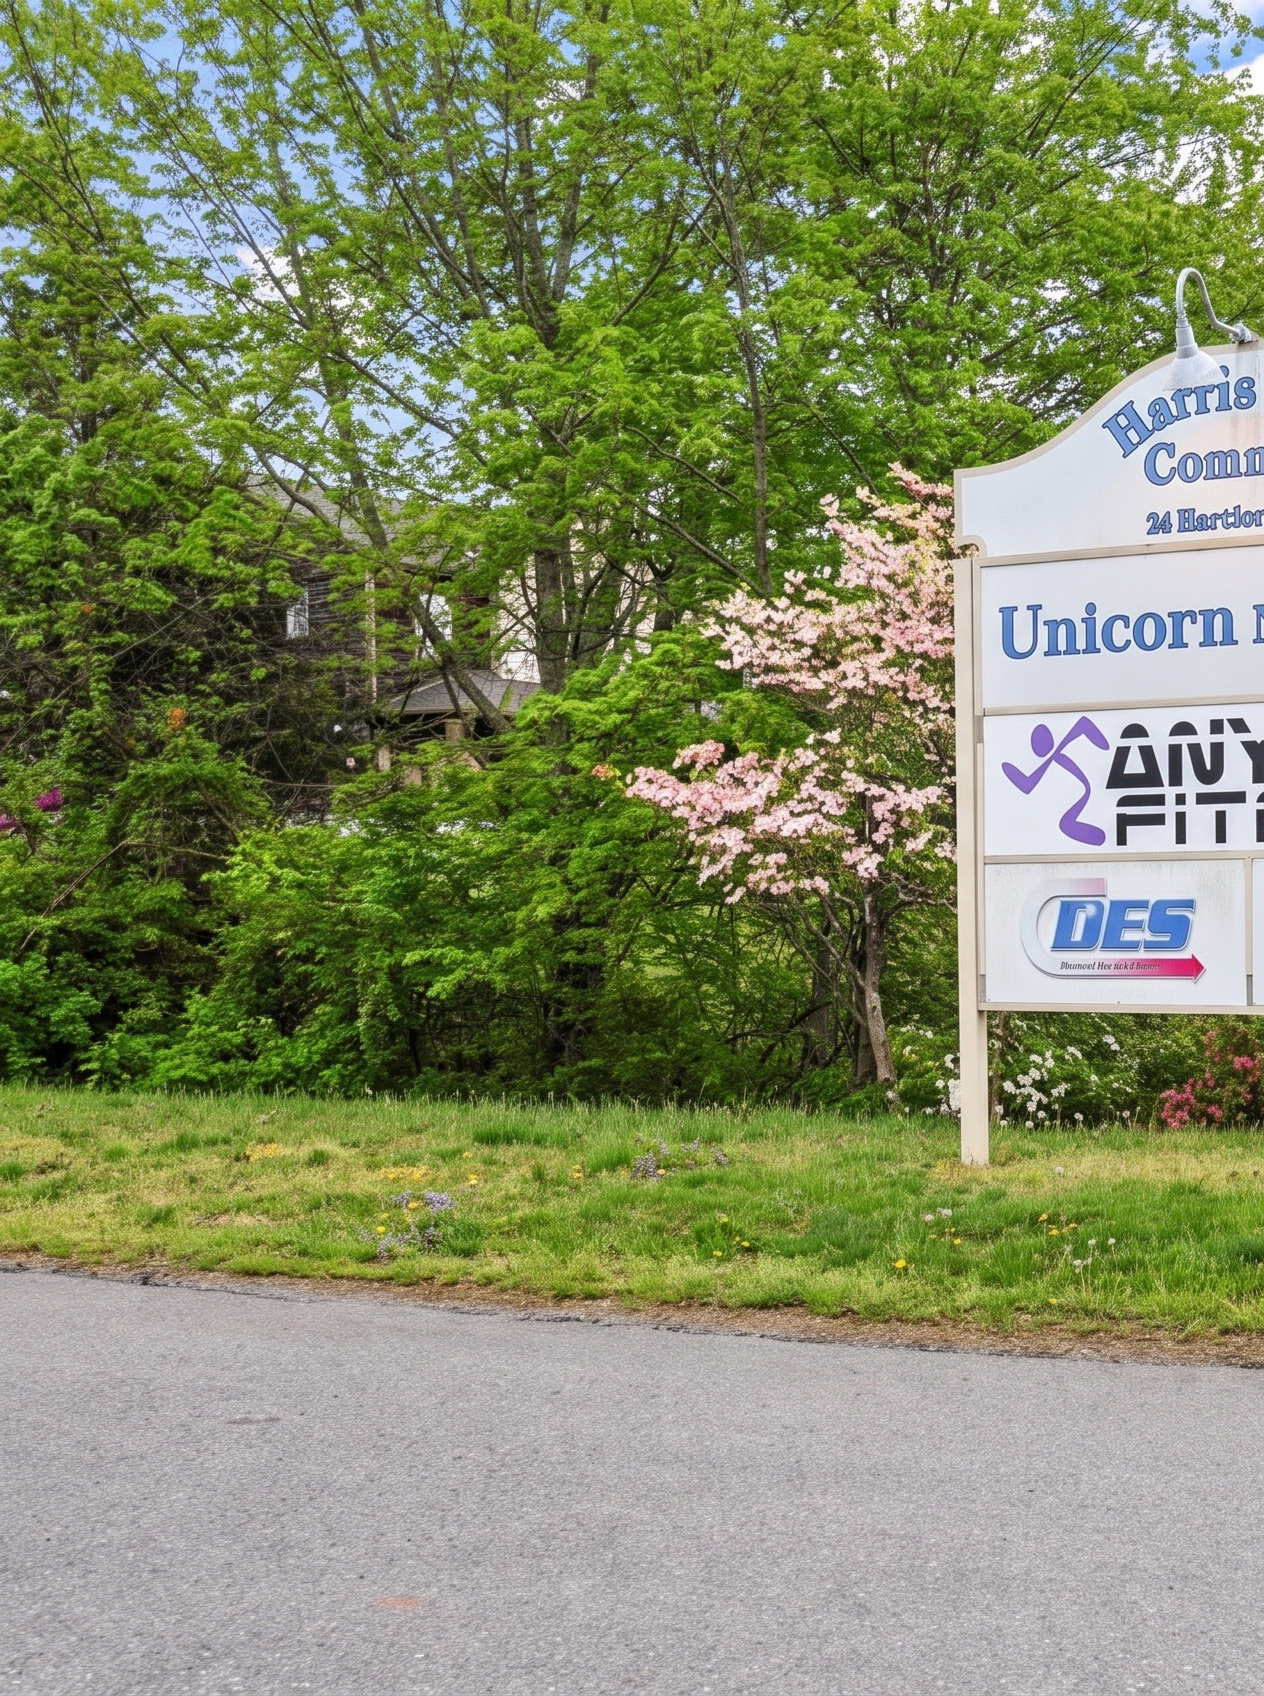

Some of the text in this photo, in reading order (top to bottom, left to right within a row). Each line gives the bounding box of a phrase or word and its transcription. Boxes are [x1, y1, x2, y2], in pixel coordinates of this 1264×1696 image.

[1102, 365, 1256, 458] Harris
[1146, 511, 1172, 535] 24
[999, 602, 1238, 660] Unicorn
[1050, 898, 1197, 952] DES
